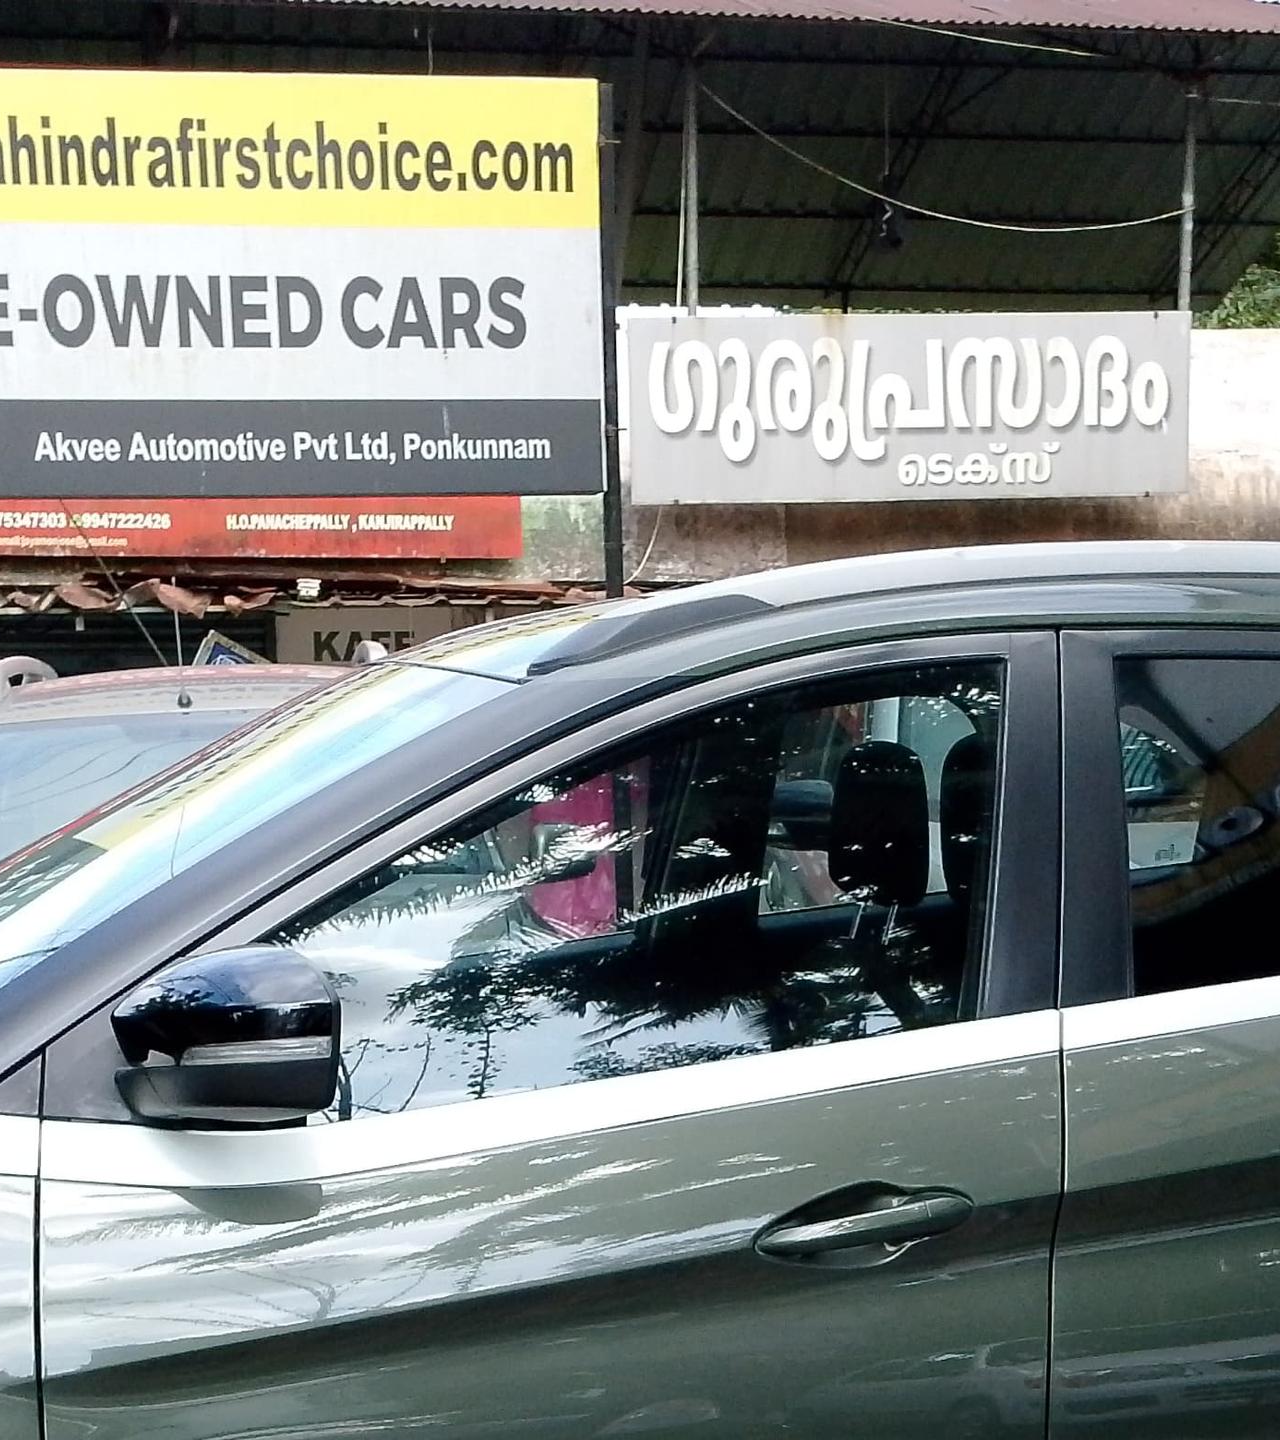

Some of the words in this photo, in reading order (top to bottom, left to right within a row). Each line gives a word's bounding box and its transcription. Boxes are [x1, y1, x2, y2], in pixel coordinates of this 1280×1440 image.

[340, 276, 527, 350] CARS
[648, 334, 1170, 463] ഗുരുപ്രസാദം
[34, 431, 122, 462] Akvee
[128, 432, 287, 462] Automotive
[292, 433, 338, 461] Pvt
[344, 431, 397, 466] Ltd,
[403, 432, 552, 461] Ponkunnam
